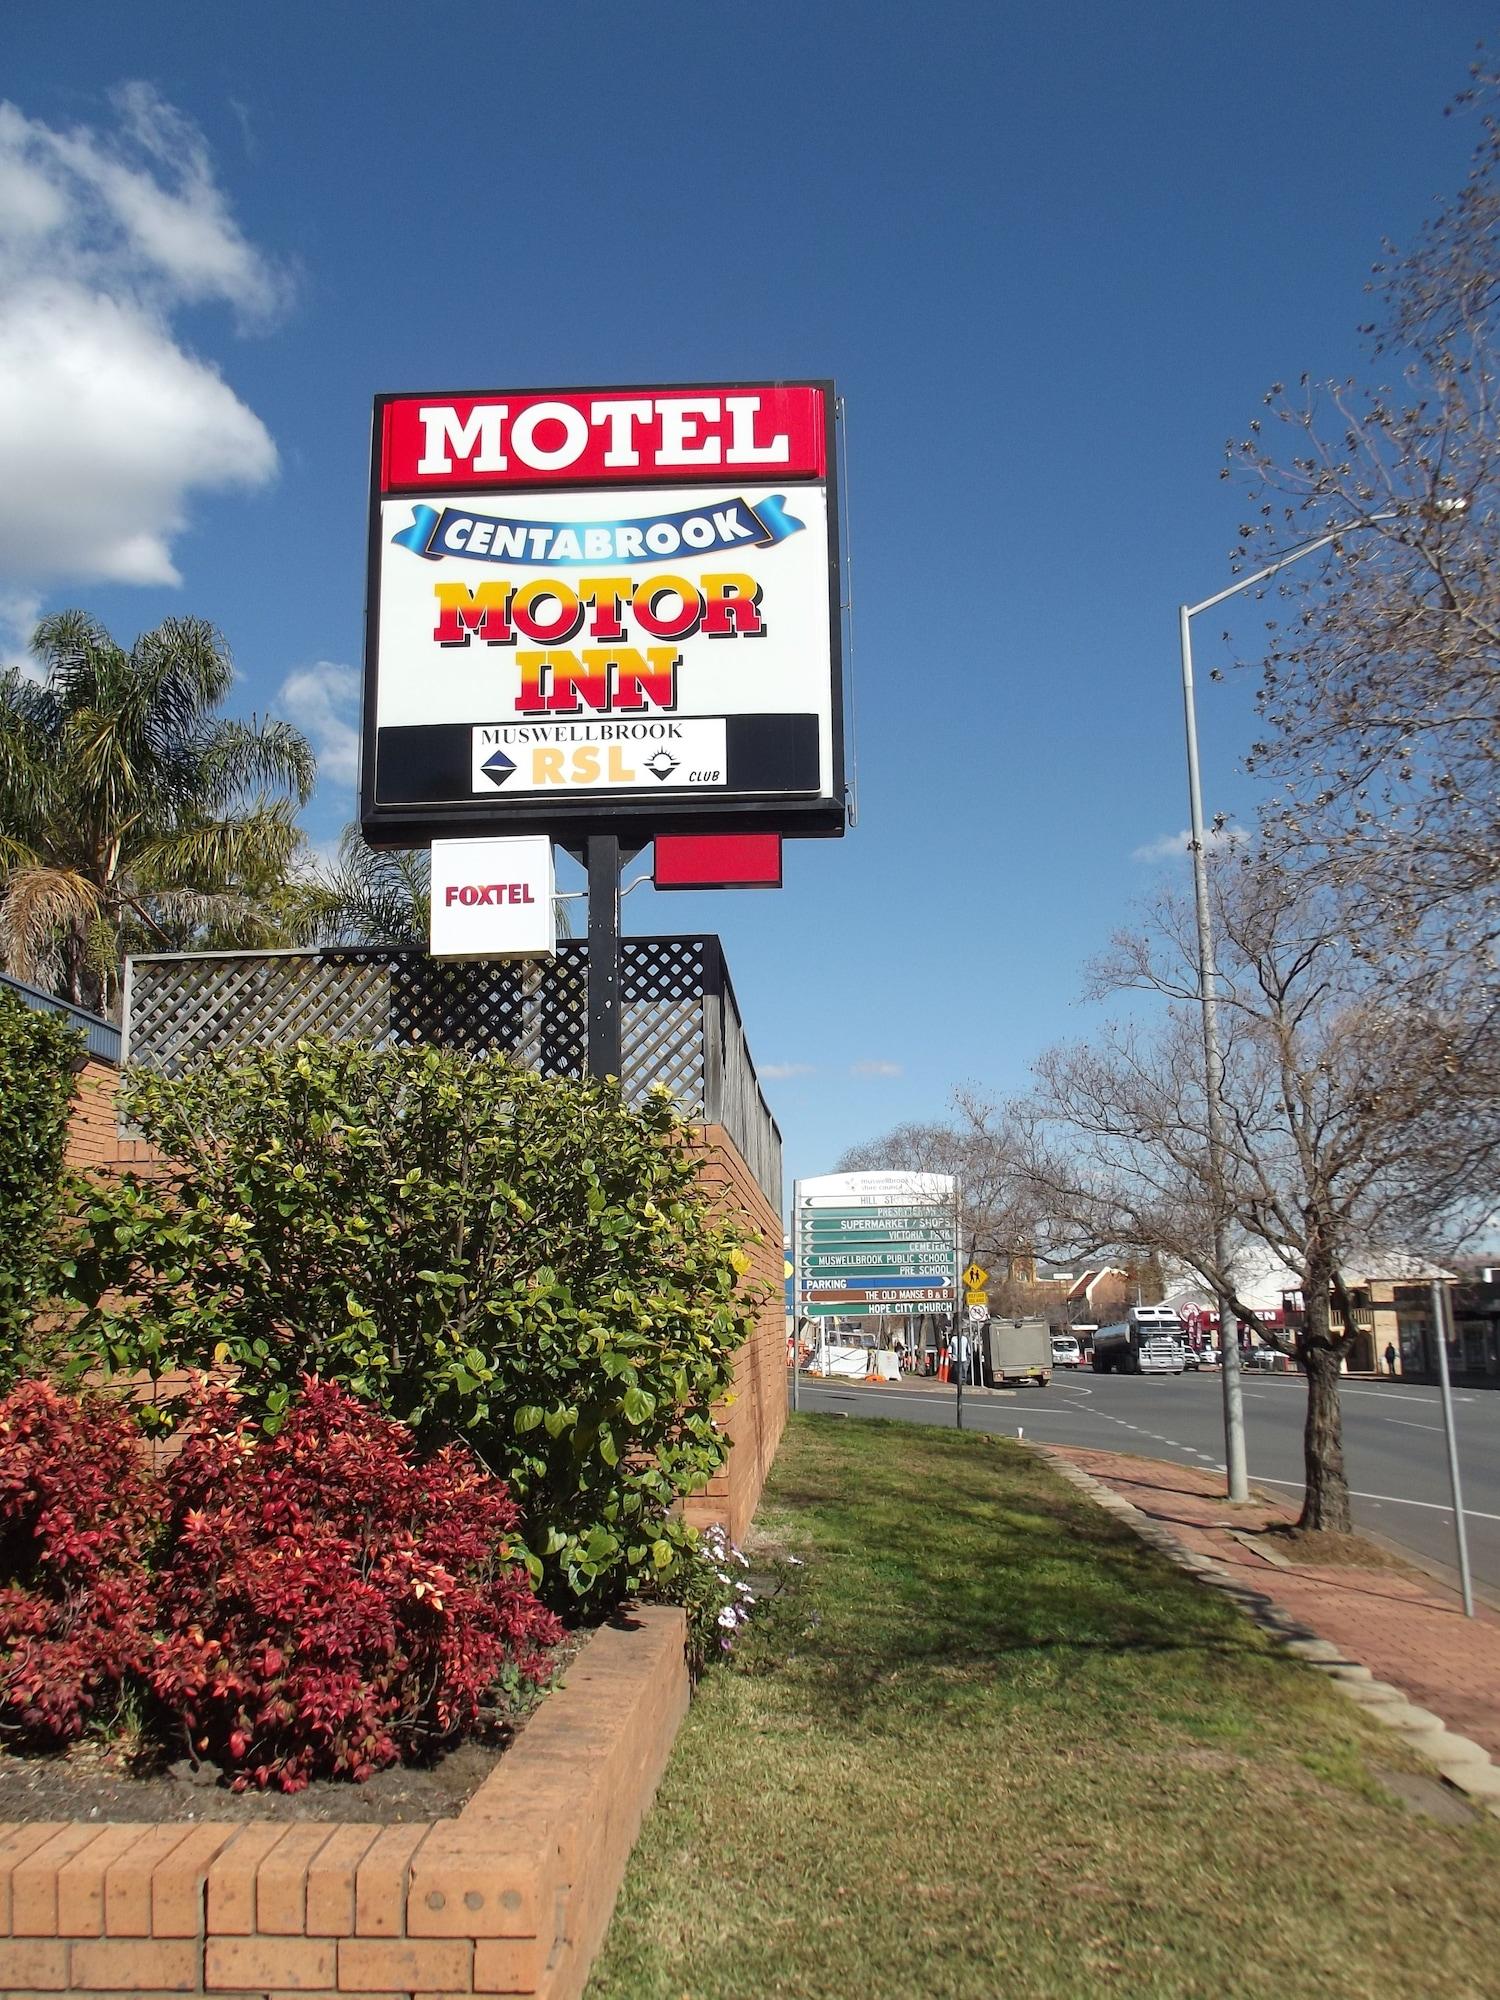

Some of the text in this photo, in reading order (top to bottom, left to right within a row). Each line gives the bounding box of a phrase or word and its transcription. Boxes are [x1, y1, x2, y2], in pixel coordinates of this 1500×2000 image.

[417, 396, 790, 475] MOTEL
[444, 508, 754, 560] CENTABROOK
[433, 573, 767, 647] MOTOR
[514, 647, 683, 716] INN
[481, 722, 683, 745] MUSWELLBROOK
[532, 745, 636, 785] RSL
[688, 770, 720, 783] CLUB
[445, 883, 535, 907] FOXTEL
[860, 1195, 877, 1205] HILL
[840, 1219, 909, 1230] SUPERMARKET
[920, 1217, 951, 1228] SHOPS
[889, 1229, 951, 1240] VICTORIA PARK
[818, 1252, 950, 1266] MUSWELLBROOK PUBLIC SCHOOL
[900, 1264, 951, 1275] PRE SCHOOL
[806, 1279, 848, 1290] PARKING
[865, 1290, 879, 1300] THE
[882, 1290, 897, 1300] OLD
[900, 1289, 925, 1299] MANSE
[927, 1289, 934, 1299] B
[943, 1289, 949, 1299] B
[868, 1301, 953, 1314] HOPE CITY CHURCH
